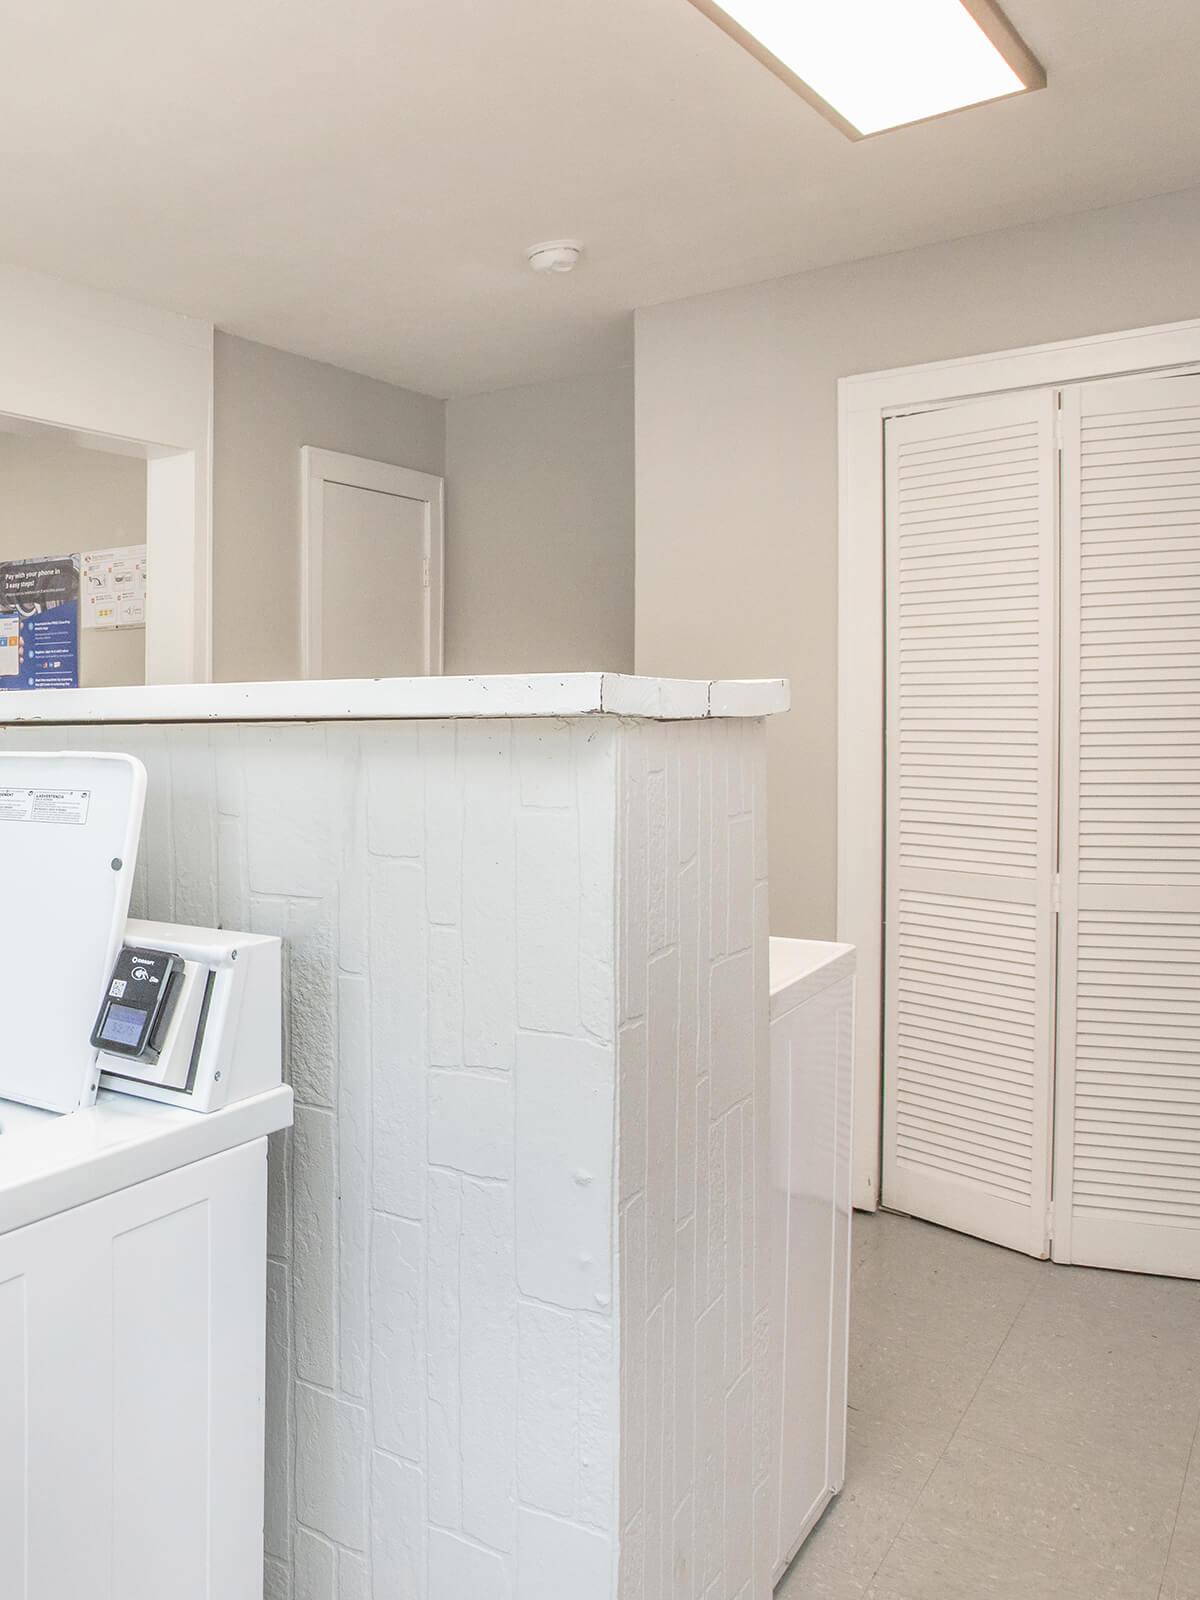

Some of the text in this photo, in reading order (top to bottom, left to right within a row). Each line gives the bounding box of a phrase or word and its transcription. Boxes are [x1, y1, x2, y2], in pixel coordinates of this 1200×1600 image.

[26, 571, 37, 579] your
[38, 569, 54, 577] phone
[20, 580, 35, 588] steps!
